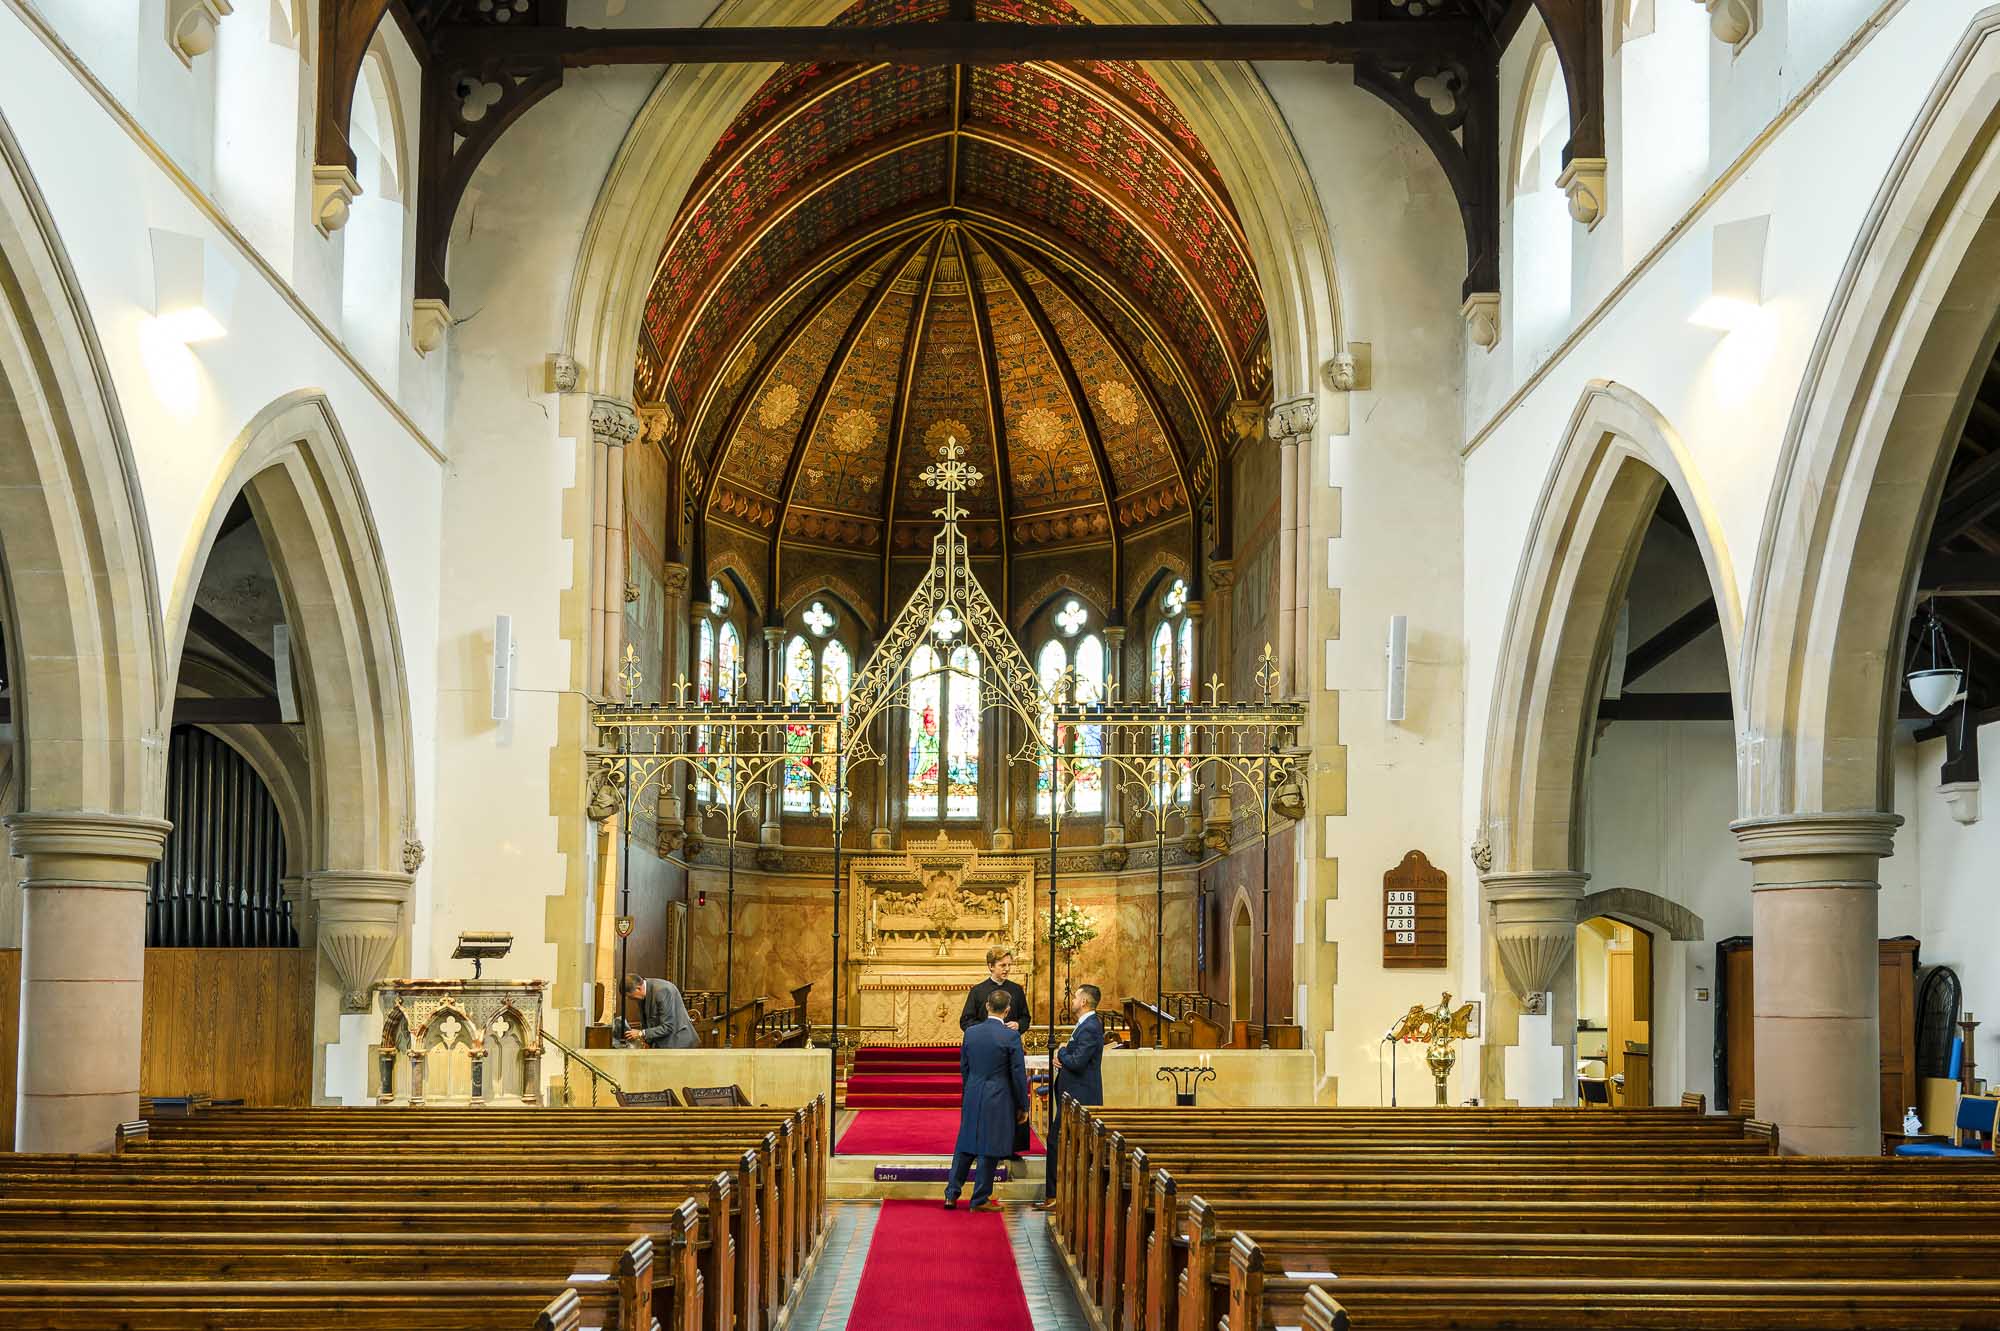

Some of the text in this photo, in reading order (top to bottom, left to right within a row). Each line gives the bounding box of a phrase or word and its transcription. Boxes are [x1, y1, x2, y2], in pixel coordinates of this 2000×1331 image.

[1390, 893, 1412, 901] 306
[1390, 907, 1412, 915] 753
[1389, 920, 1412, 928] 738
[1398, 933, 1412, 941] 26
